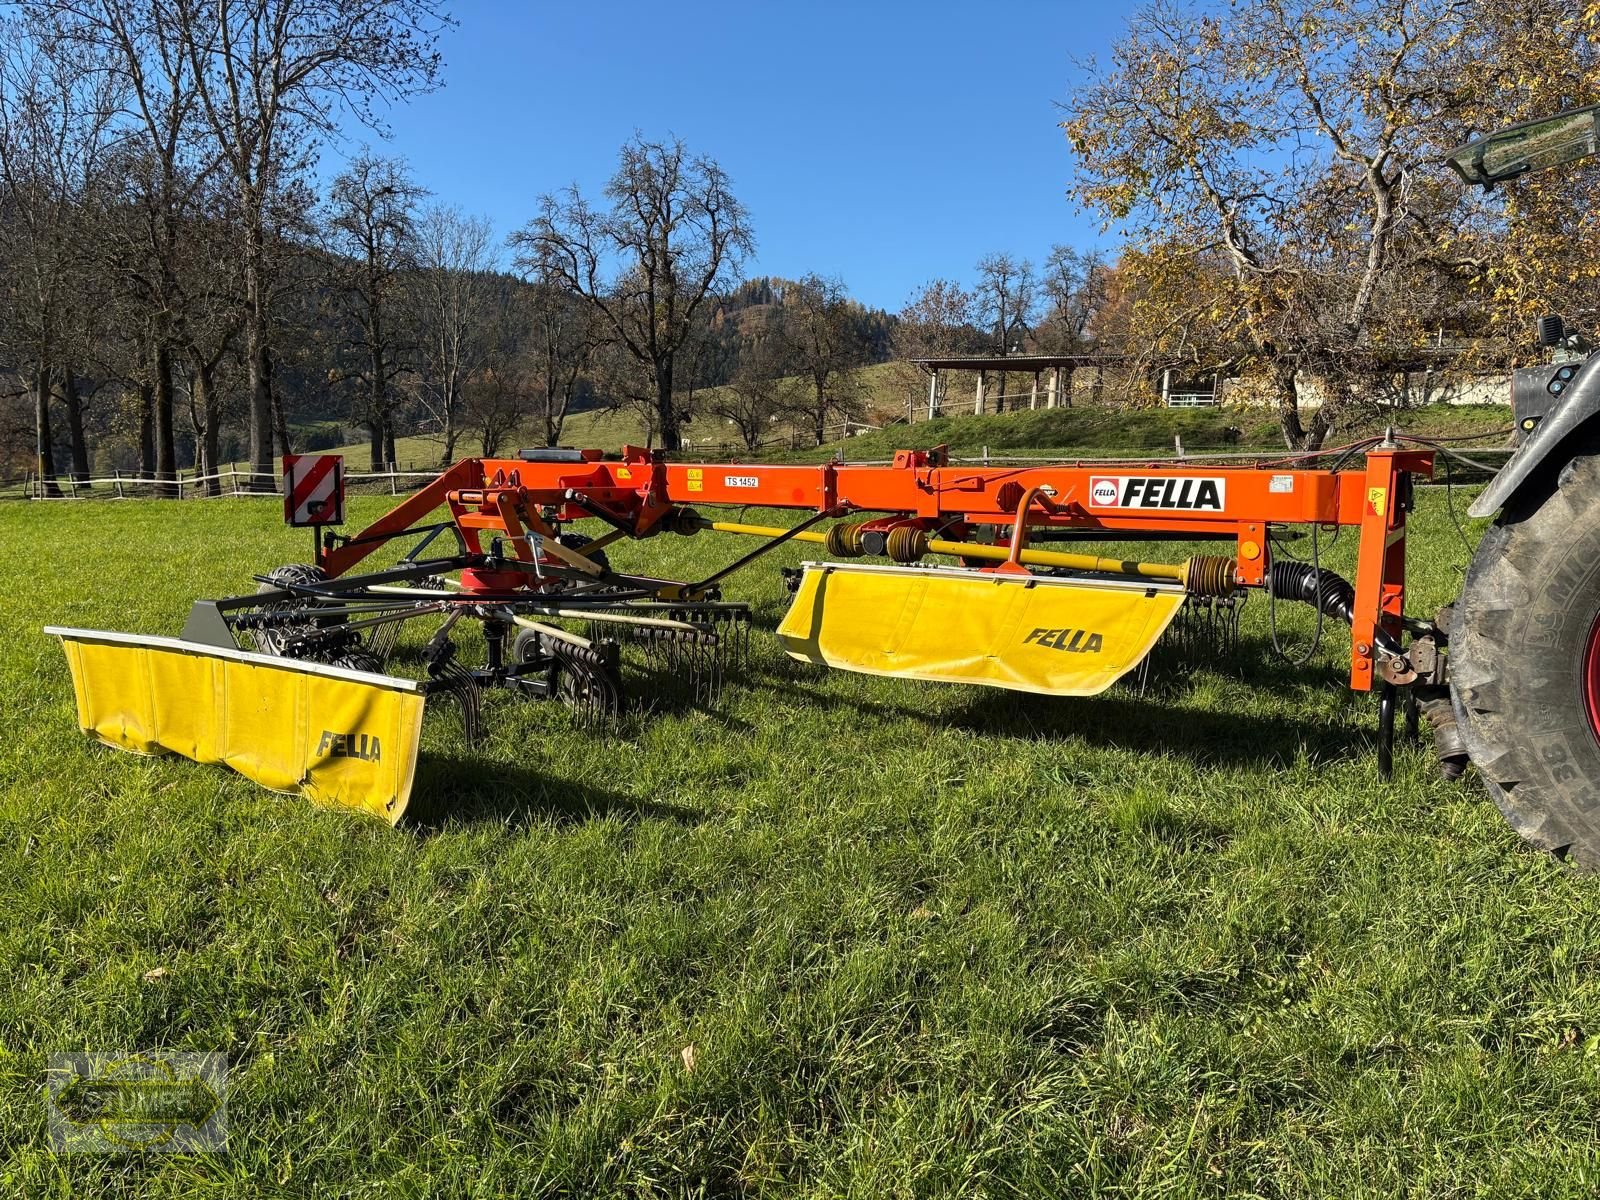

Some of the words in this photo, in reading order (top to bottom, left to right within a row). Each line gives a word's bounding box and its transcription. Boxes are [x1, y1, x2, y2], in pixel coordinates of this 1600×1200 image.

[727, 477, 738, 486] TS
[739, 478, 756, 487] 1452
[1094, 488, 1116, 497] FELLA
[1120, 478, 1222, 510] FELLA
[1022, 627, 1103, 654] FELLA
[316, 730, 381, 767] FELLA
